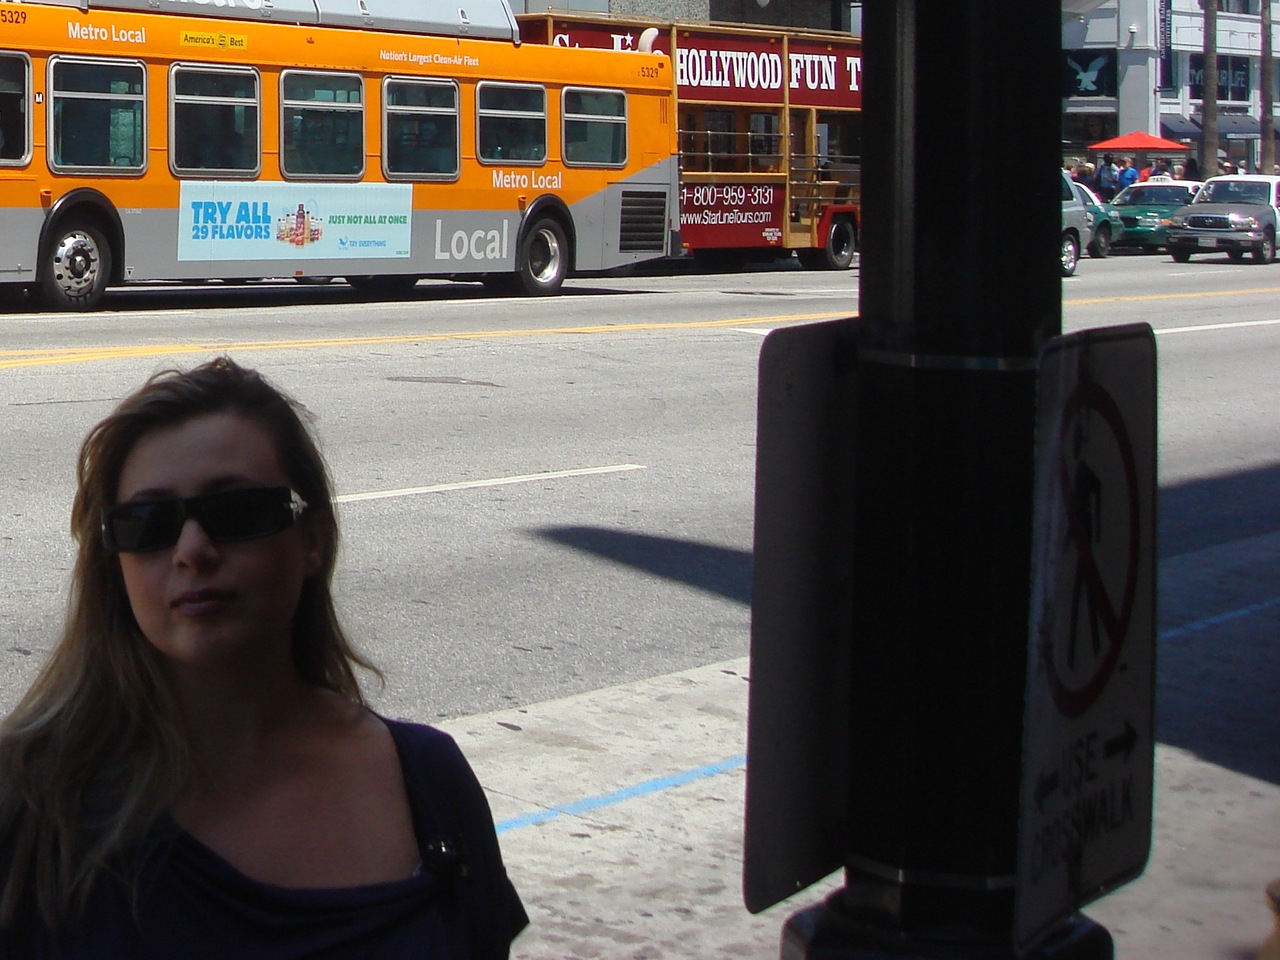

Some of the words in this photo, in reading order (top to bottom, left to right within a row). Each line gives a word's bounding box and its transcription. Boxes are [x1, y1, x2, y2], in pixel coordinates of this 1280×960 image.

[0, 9, 27, 25] 5329
[67, 21, 108, 41] Metro
[111, 24, 146, 44] Local
[183, 34, 215, 45] America's
[230, 37, 244, 47] Best
[379, 49, 407, 62] Nation's
[408, 52, 433, 65] Largest
[433, 54, 463, 65] Clean-Air
[463, 56, 479, 67] Fleet
[641, 66, 659, 78] 5329
[676, 48, 782, 90] HOLLYWOOD
[789, 53, 837, 91] FUN
[492, 170, 528, 188] Metro
[531, 171, 562, 189] Local
[681, 186, 773, 206] 1-800-959-3131
[191, 202, 233, 224] TRY
[235, 201, 271, 224] ALL
[328, 215, 345, 224] JUST
[347, 215, 363, 224] NOT
[363, 215, 376, 224] ALL
[377, 215, 387, 224] AT
[387, 215, 407, 224] ONCE
[679, 208, 772, 225] www.StarLineTours.com
[192, 226, 209, 239] 29
[211, 225, 271, 239] FLAVORS
[434, 219, 509, 260] Local
